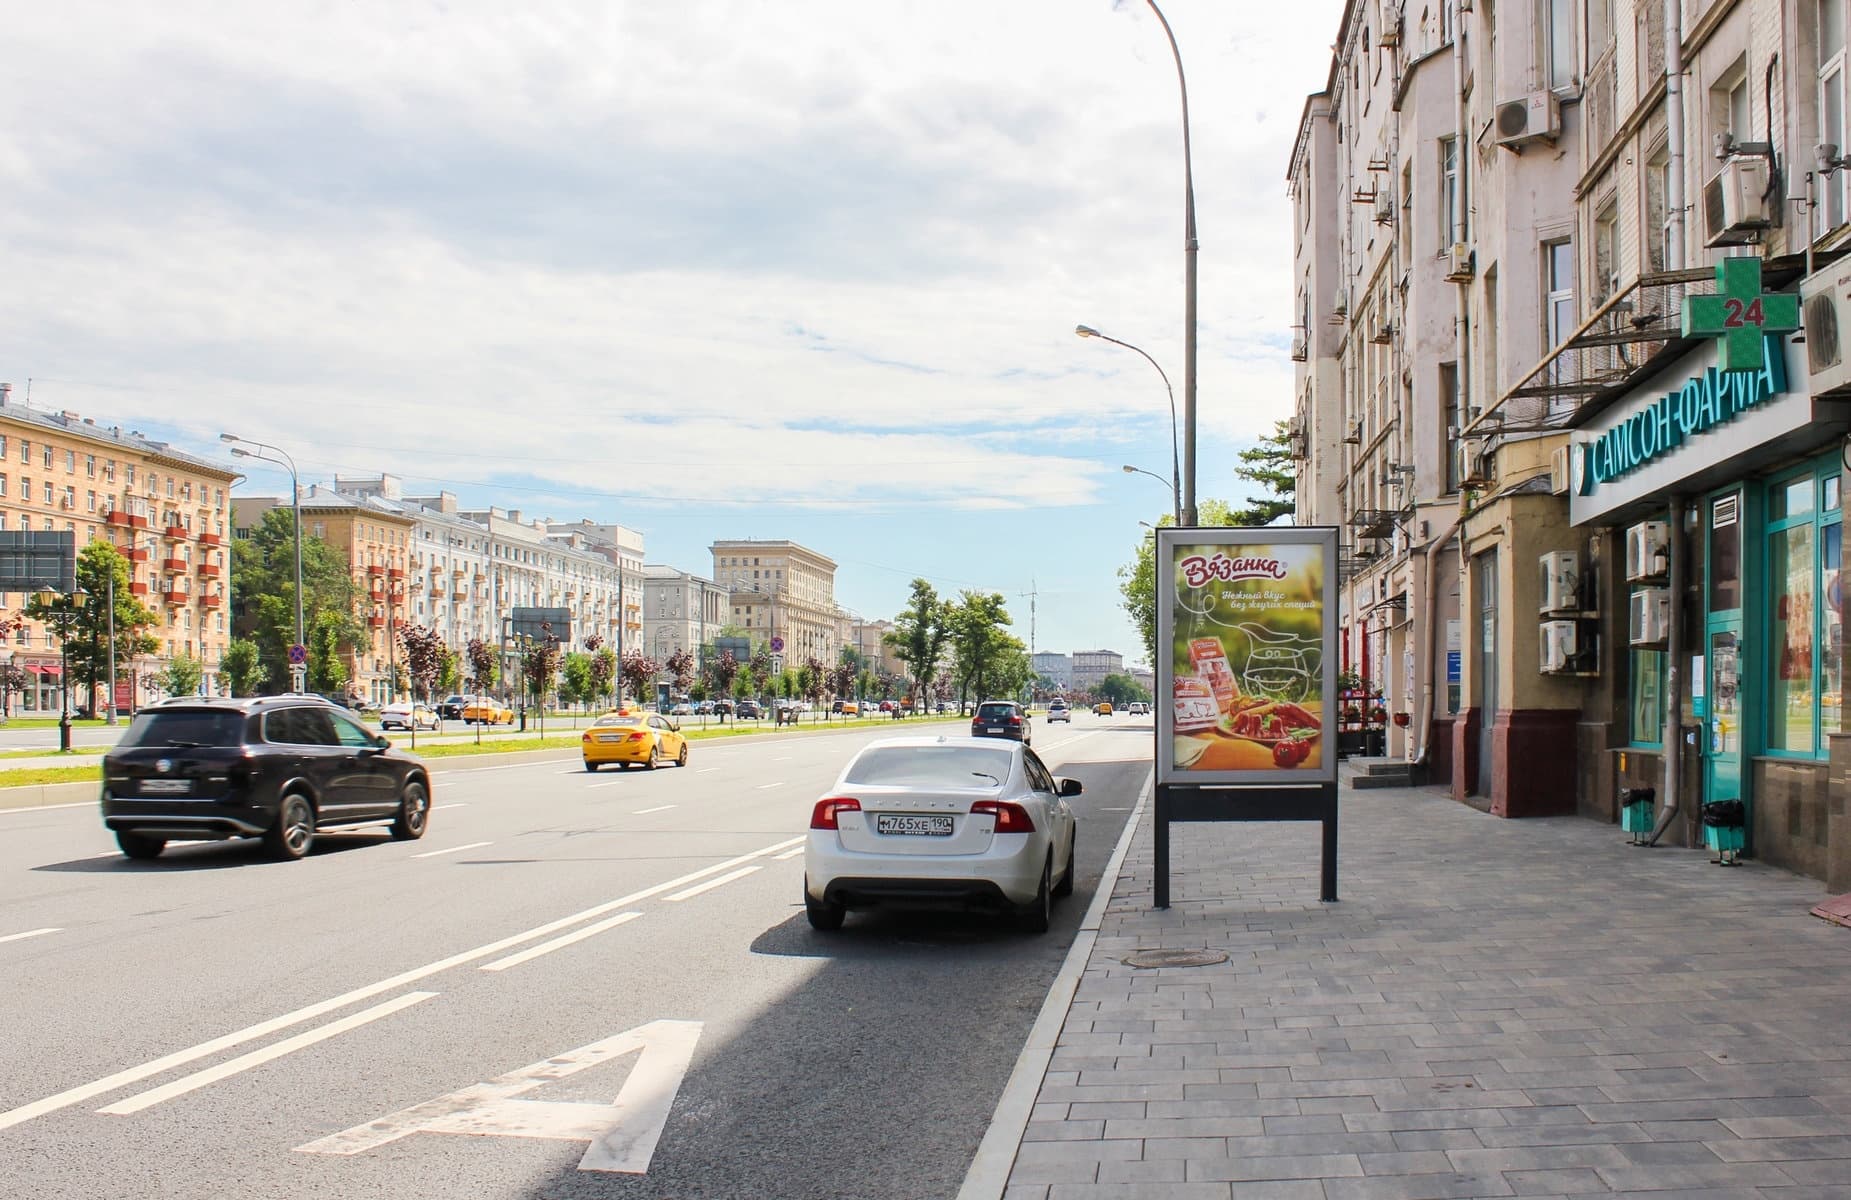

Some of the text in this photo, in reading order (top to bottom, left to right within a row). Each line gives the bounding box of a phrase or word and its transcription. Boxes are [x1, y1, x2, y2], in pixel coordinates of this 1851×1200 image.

[1724, 299, 1765, 328] 24
[1592, 335, 1777, 484] САМСОН-ФАРМА
[1180, 554, 1287, 588] Вязанка
